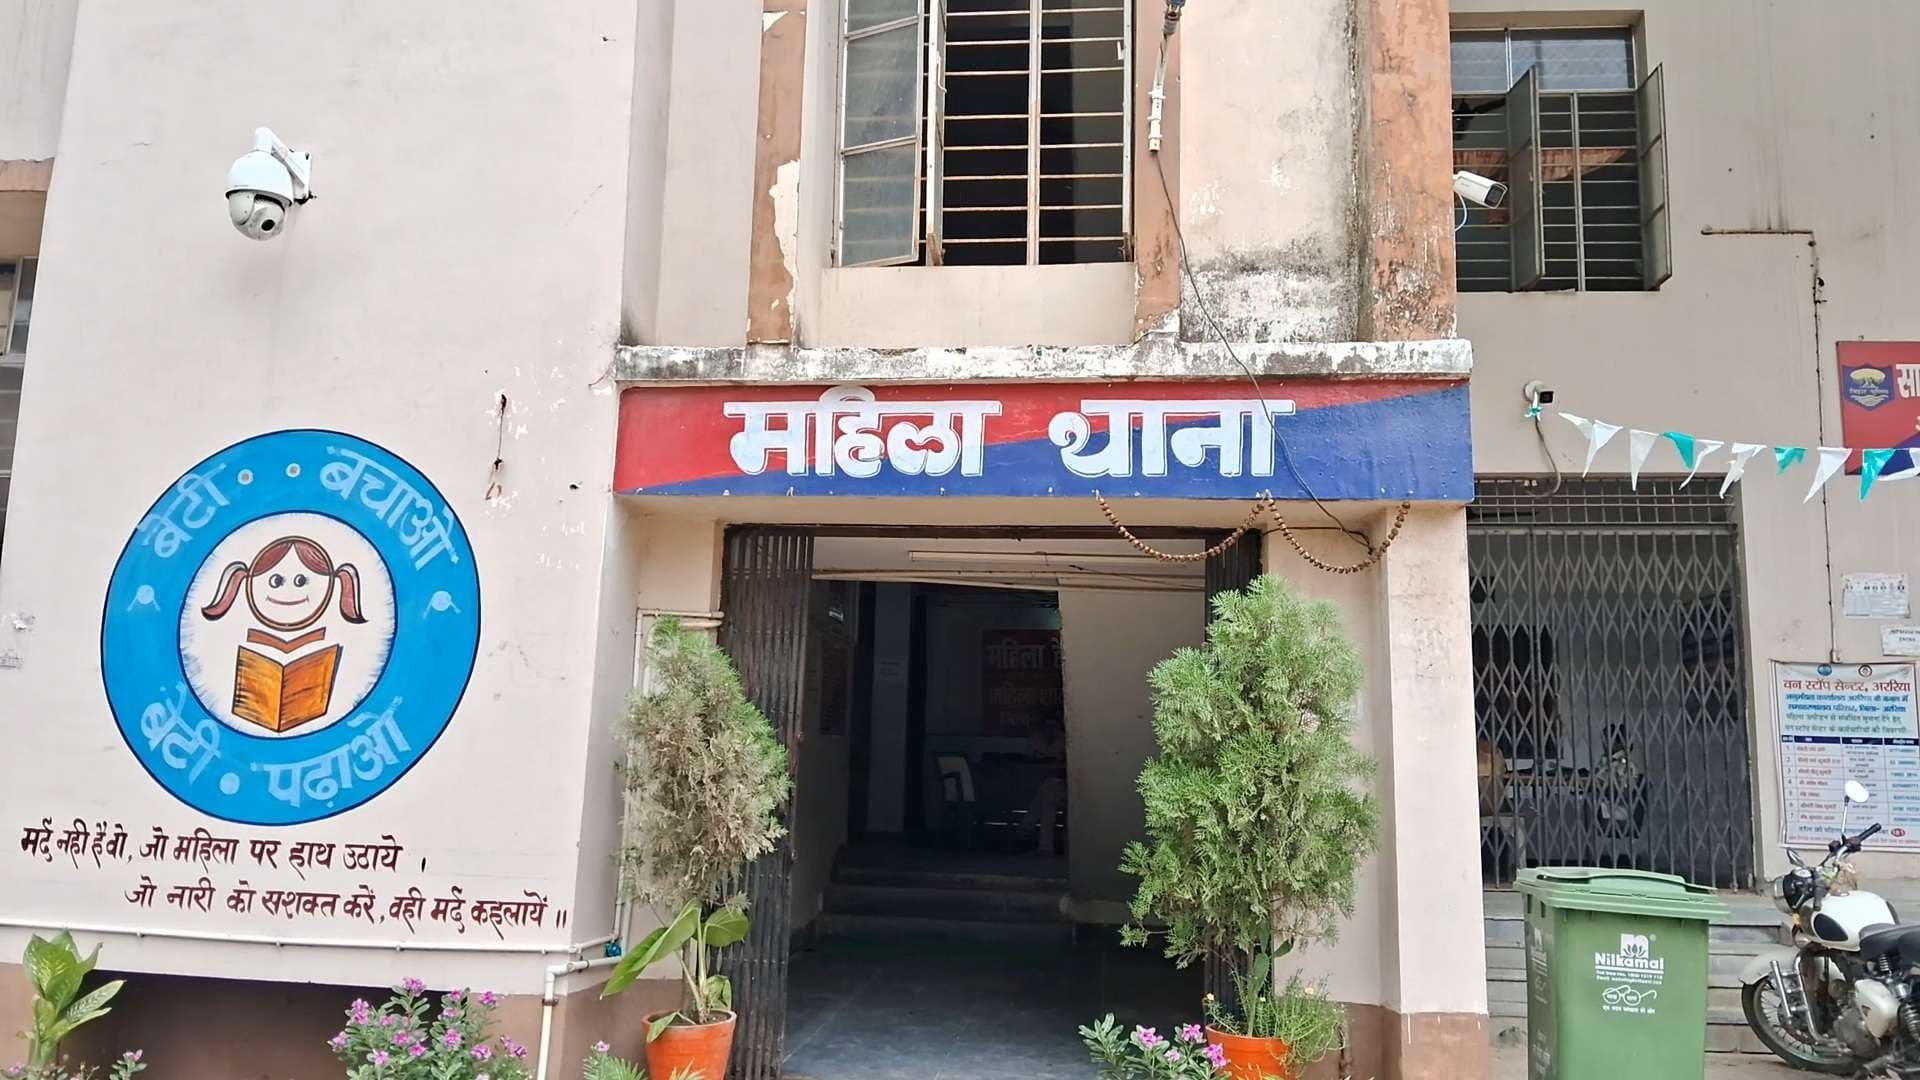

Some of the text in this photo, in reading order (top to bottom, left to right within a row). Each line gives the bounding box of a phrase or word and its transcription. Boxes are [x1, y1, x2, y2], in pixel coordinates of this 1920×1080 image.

[724, 386, 1296, 477] महिला थाना
[137, 446, 460, 570] बेटी बचाओ
[1784, 680, 1801, 690] वन
[1873, 681, 1911, 693] अररिया
[140, 681, 411, 808] बेटी पढ़ाओ
[21, 818, 53, 862] मर्द
[57, 818, 90, 869] नही
[139, 826, 169, 861] जो
[174, 827, 239, 873] महिला
[249, 838, 281, 869] पर
[288, 842, 336, 880] हाथ
[342, 834, 403, 873] उठाये
[124, 876, 157, 909] जो
[166, 876, 215, 913] नारी
[226, 879, 256, 914] को
[262, 889, 340, 920] सशक्त
[388, 887, 425, 935] वही
[430, 885, 466, 934] मर्द
[471, 889, 548, 940] कहलायें
[1595, 952, 1664, 970] Nilkamal
